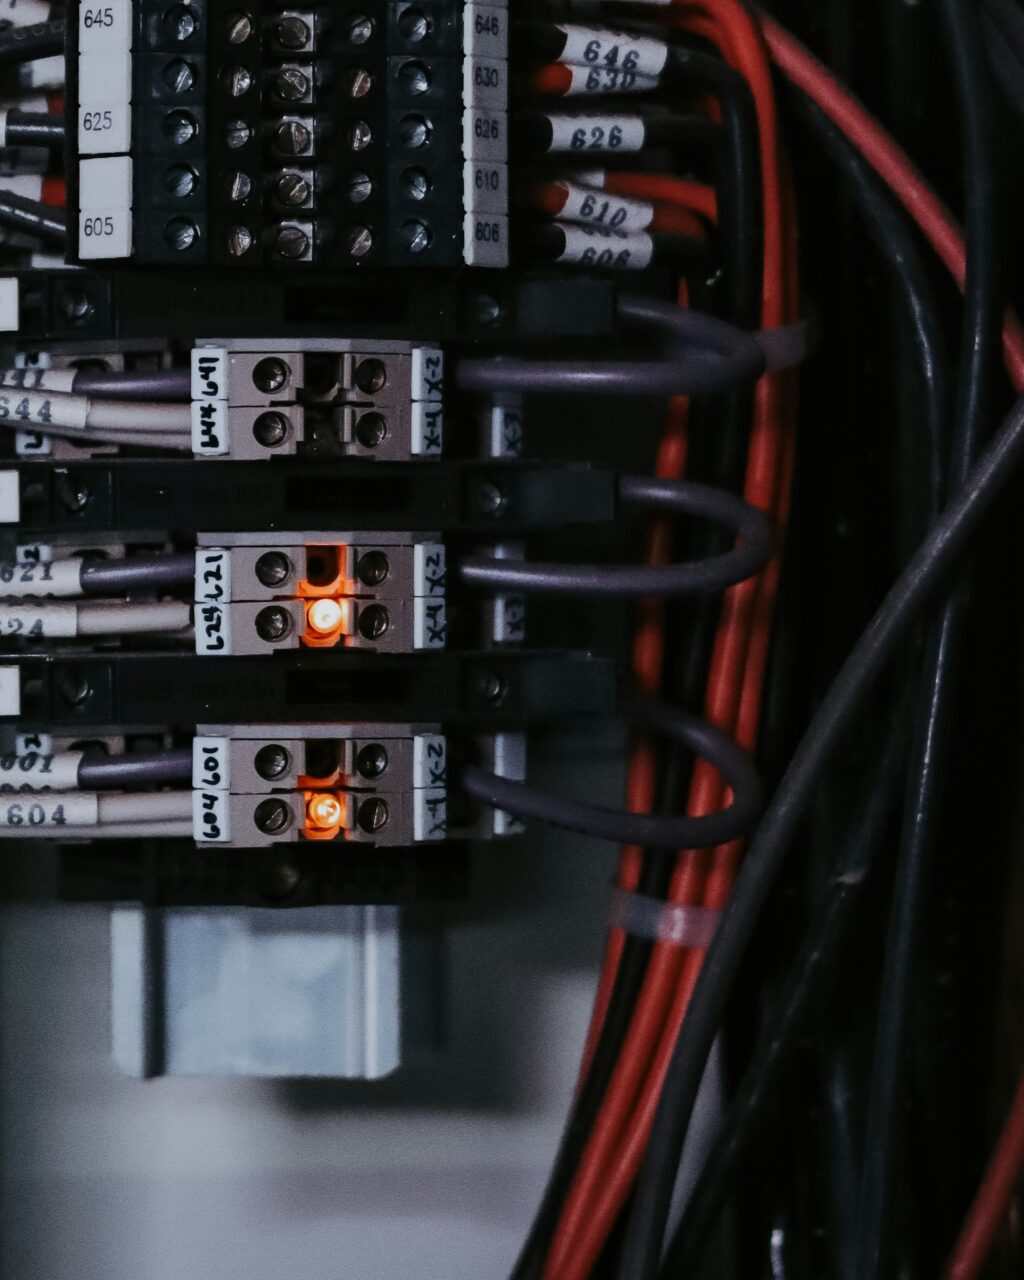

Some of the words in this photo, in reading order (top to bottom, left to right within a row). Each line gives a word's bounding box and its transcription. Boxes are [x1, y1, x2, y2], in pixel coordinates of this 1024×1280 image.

[84, 8, 113, 28] 645
[583, 40, 640, 69] 646
[475, 68, 499, 87] 630
[84, 111, 111, 131] 625
[475, 119, 499, 138] 626
[571, 125, 623, 149] 626
[475, 171, 499, 190] 610
[579, 194, 627, 226] 610
[84, 217, 113, 236] 605
[475, 223, 500, 242] 606
[195, 357, 223, 400] 641
[0, 562, 53, 582] 621
[199, 747, 220, 789] 601
[7, 804, 67, 826] 604
[199, 794, 224, 843] 604
